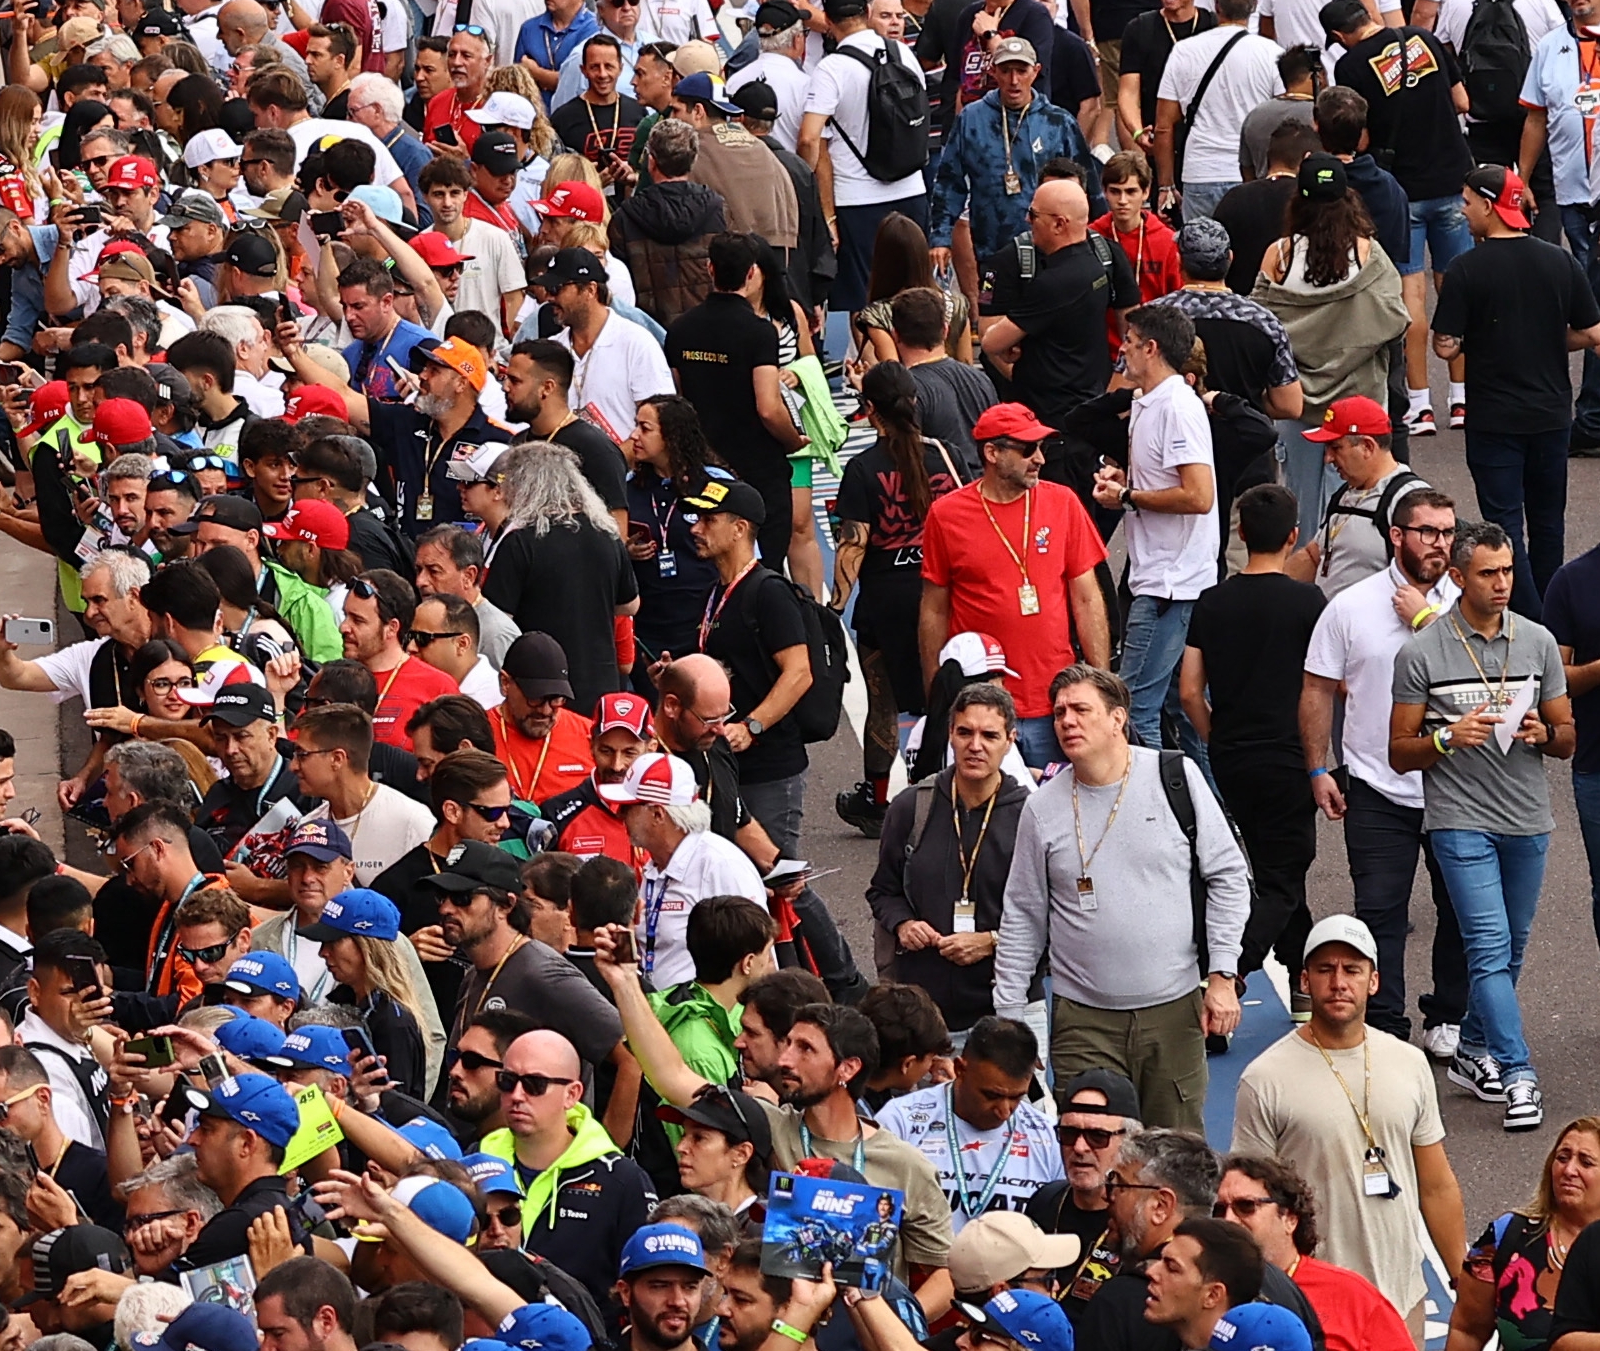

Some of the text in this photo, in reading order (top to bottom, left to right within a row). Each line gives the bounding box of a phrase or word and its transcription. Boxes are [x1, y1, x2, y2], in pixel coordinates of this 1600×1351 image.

[569, 206, 587, 219] FOX
[43, 409, 59, 420] FOX
[96, 431, 109, 441] FOX
[298, 528, 318, 541] FOX
[356, 860, 384, 869] LFIGER
[811, 1196, 856, 1214] RINS
[946, 1189, 1030, 1213] UCAT
[657, 1235, 699, 1254] YAMAHA
